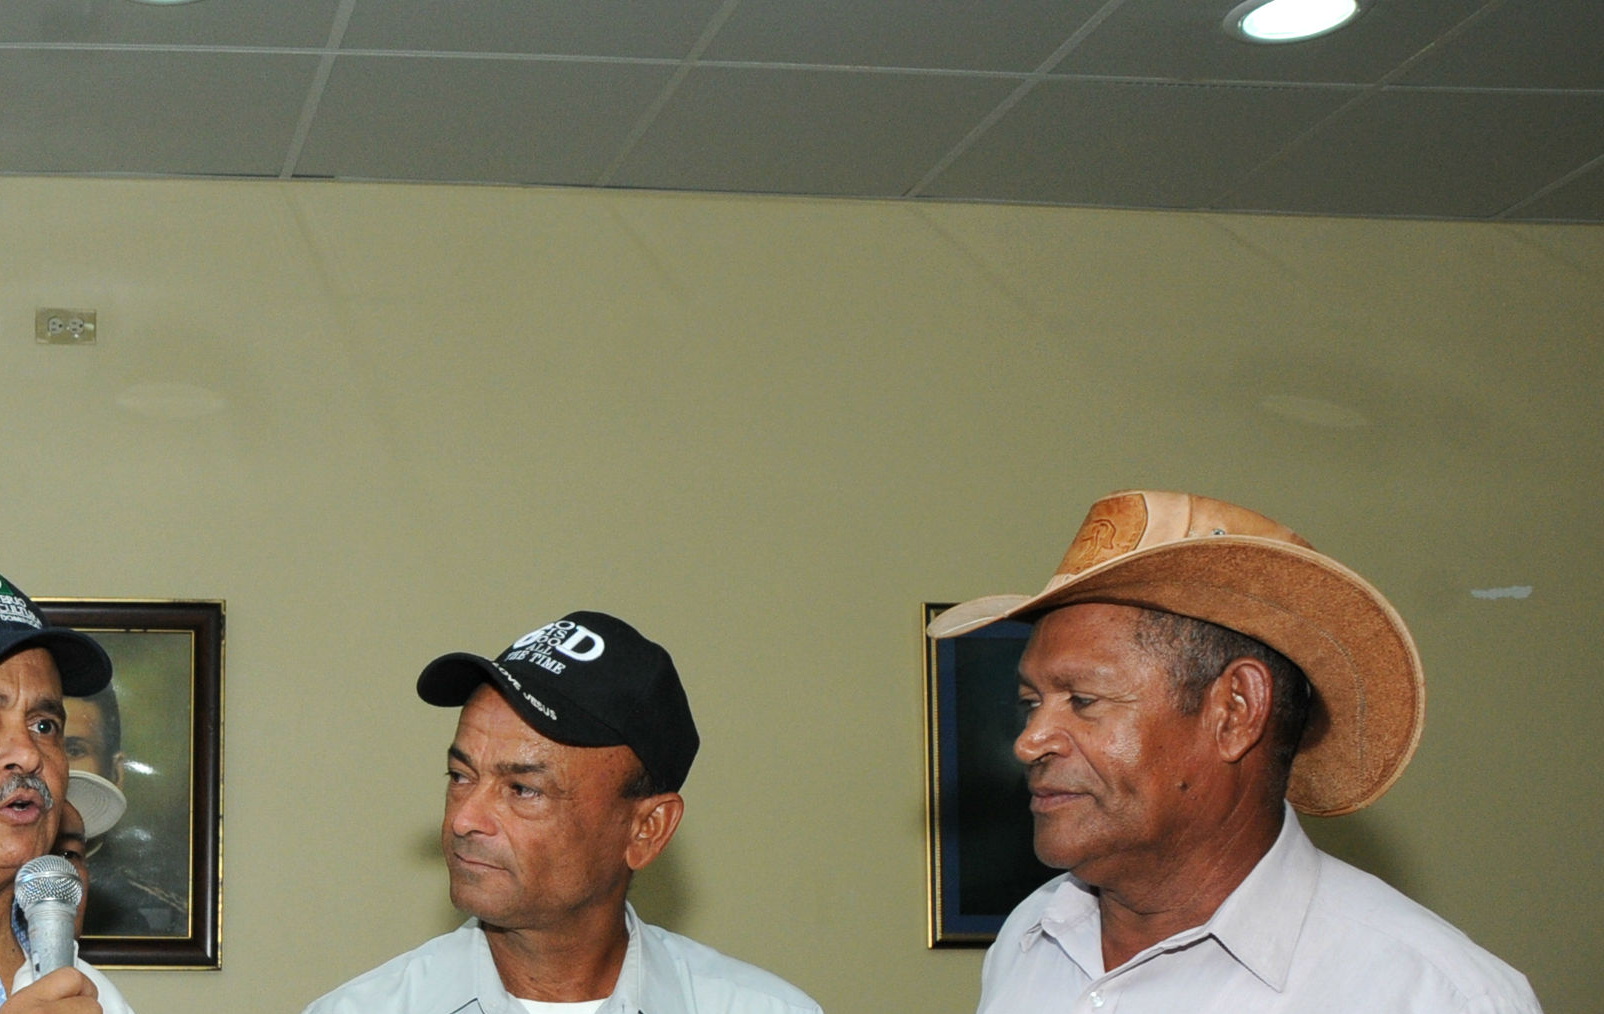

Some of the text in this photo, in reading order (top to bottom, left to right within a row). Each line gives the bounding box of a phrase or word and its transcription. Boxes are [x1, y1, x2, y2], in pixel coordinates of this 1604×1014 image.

[525, 643, 553, 656] ALL
[528, 652, 566, 675] TIME
[523, 692, 557, 720] JESUS
